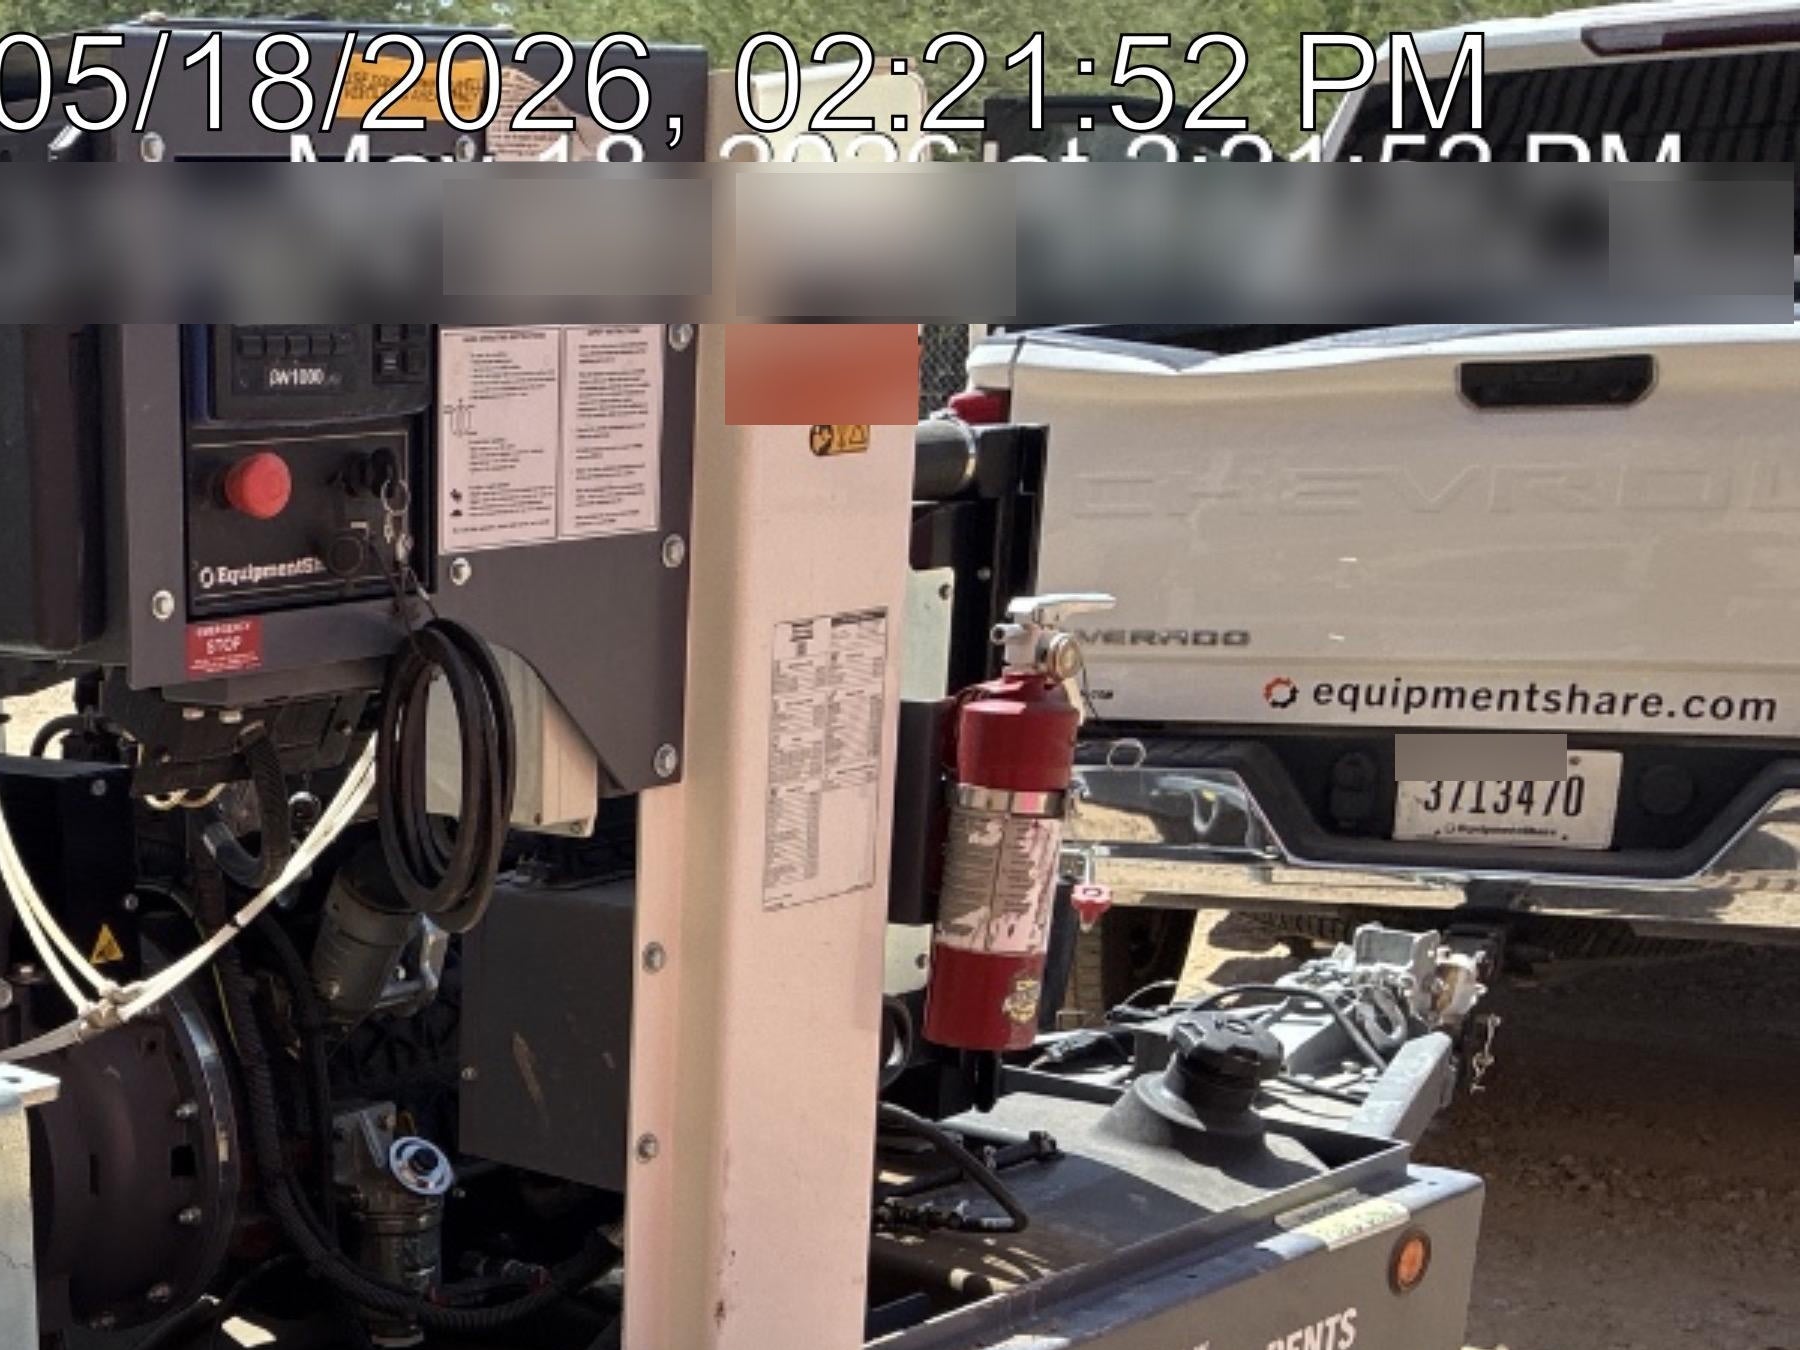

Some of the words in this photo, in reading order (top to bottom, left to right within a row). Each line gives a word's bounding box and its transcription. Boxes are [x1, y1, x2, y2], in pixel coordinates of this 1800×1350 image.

[207, 635, 241, 655] STOP
[1074, 628, 1250, 646] VERADO
[1312, 677, 1778, 722] equipmentshare.com
